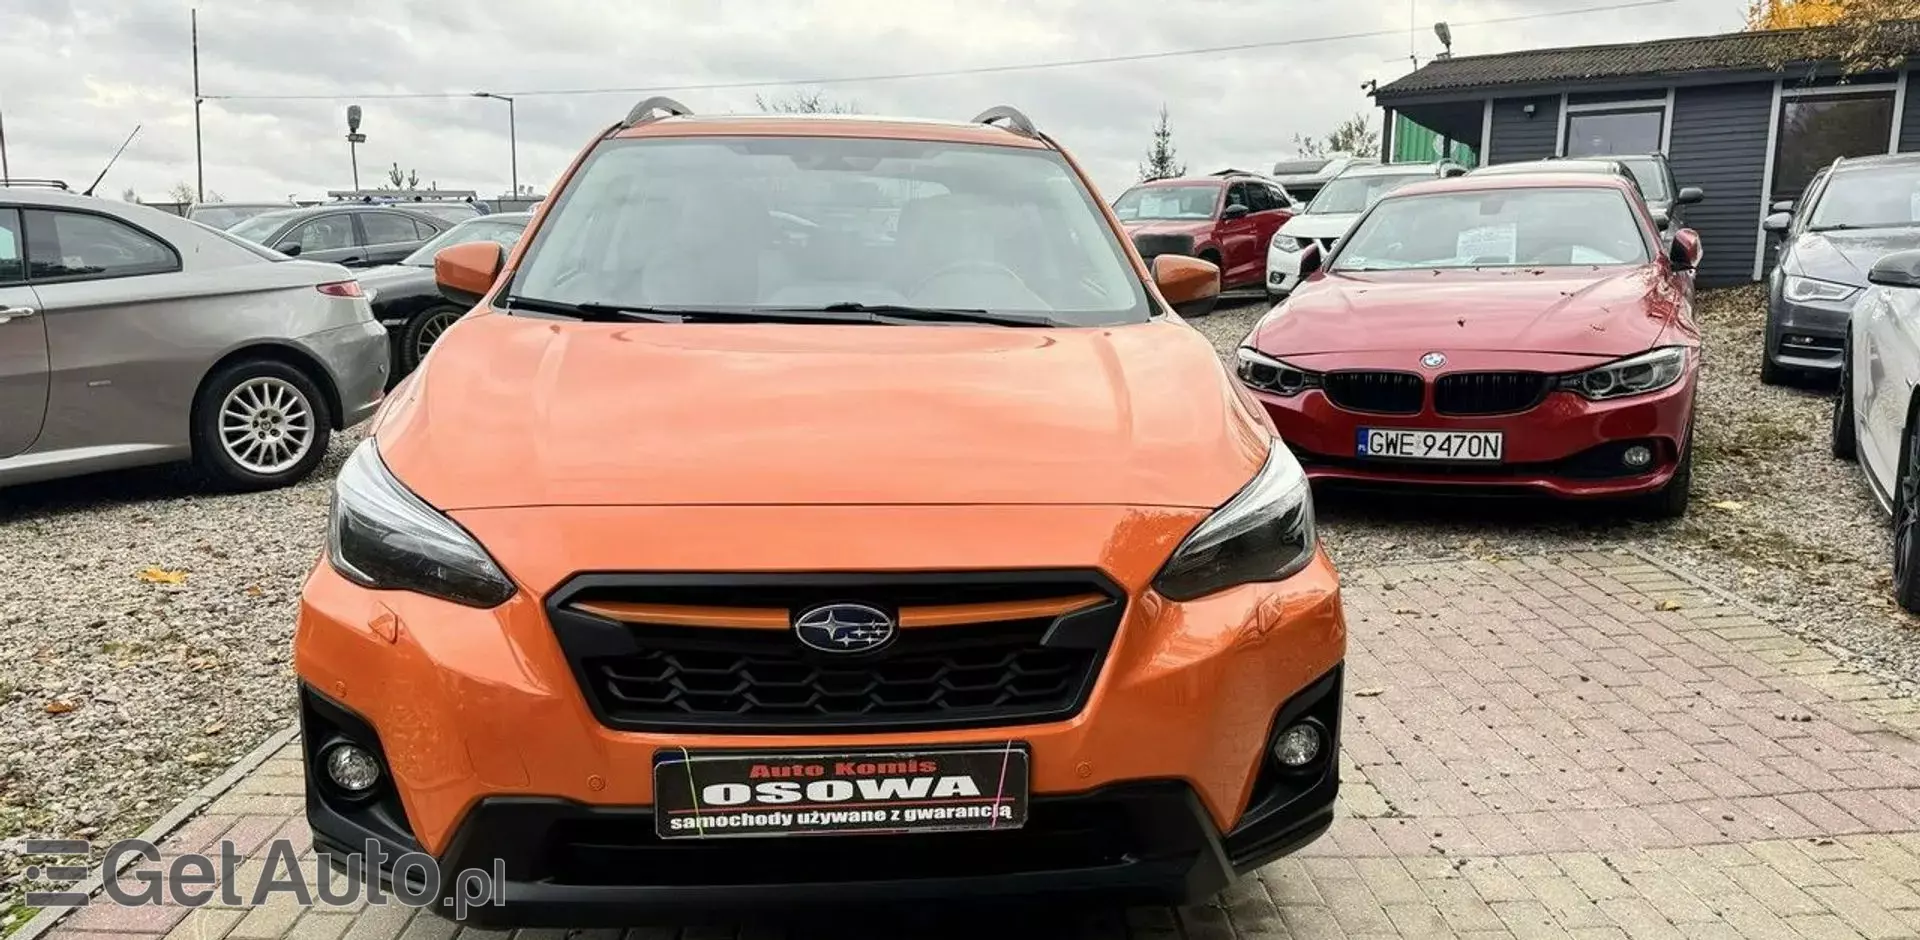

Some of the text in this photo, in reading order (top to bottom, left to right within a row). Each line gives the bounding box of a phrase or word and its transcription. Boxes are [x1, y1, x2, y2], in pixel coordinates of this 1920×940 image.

[1370, 432, 1499, 457] GWE 9470N
[750, 760, 937, 778] Auto Komis
[702, 775, 981, 806] OSOWA
[670, 811, 793, 830] samochody
[797, 811, 886, 828] używane
[891, 809, 900, 821] z
